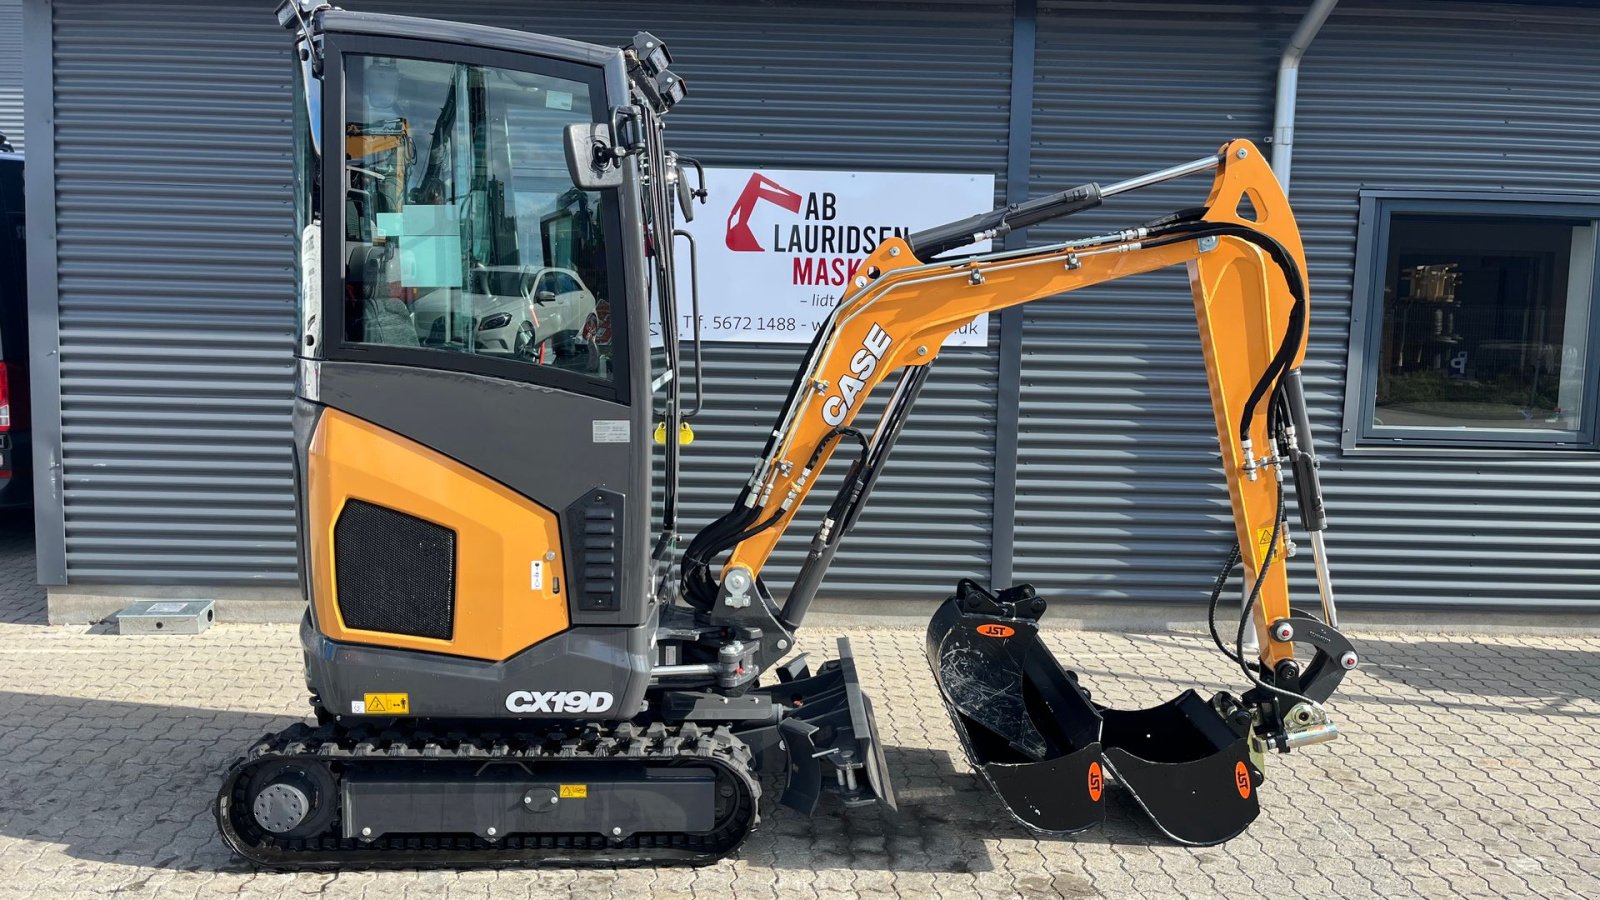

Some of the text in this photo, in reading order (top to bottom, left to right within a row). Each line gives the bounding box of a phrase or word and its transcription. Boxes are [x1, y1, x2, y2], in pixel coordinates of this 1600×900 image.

[805, 192, 836, 221] AB
[792, 257, 862, 286] MASK
[812, 293, 835, 307] lidt
[683, 315, 708, 331] Tf.
[713, 316, 752, 331] 5672
[757, 317, 796, 331] 1488
[822, 322, 893, 426] CASE
[986, 626, 1006, 636] JST
[505, 690, 614, 713] CX19D
[1090, 772, 1100, 791] JST
[1237, 771, 1249, 789] JST
